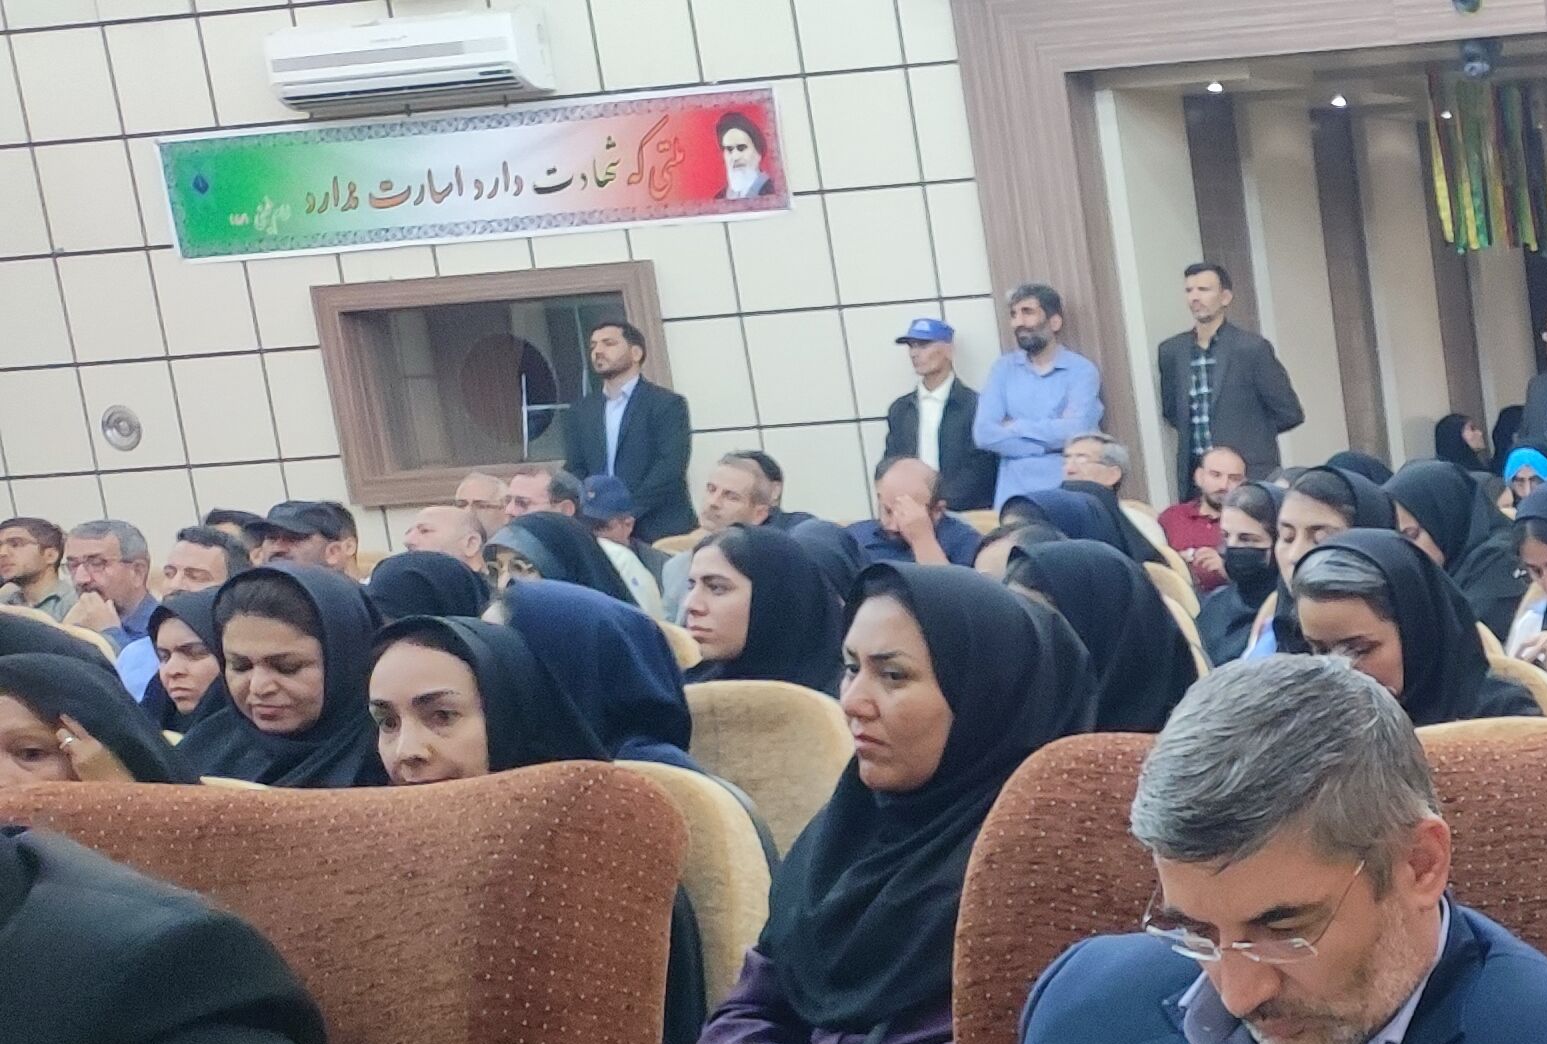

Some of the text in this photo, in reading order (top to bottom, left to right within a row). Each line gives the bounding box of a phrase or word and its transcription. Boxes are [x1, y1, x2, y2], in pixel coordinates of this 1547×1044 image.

[305, 114, 686, 214] ملتی که شهادت دارد اسارت ندارد
